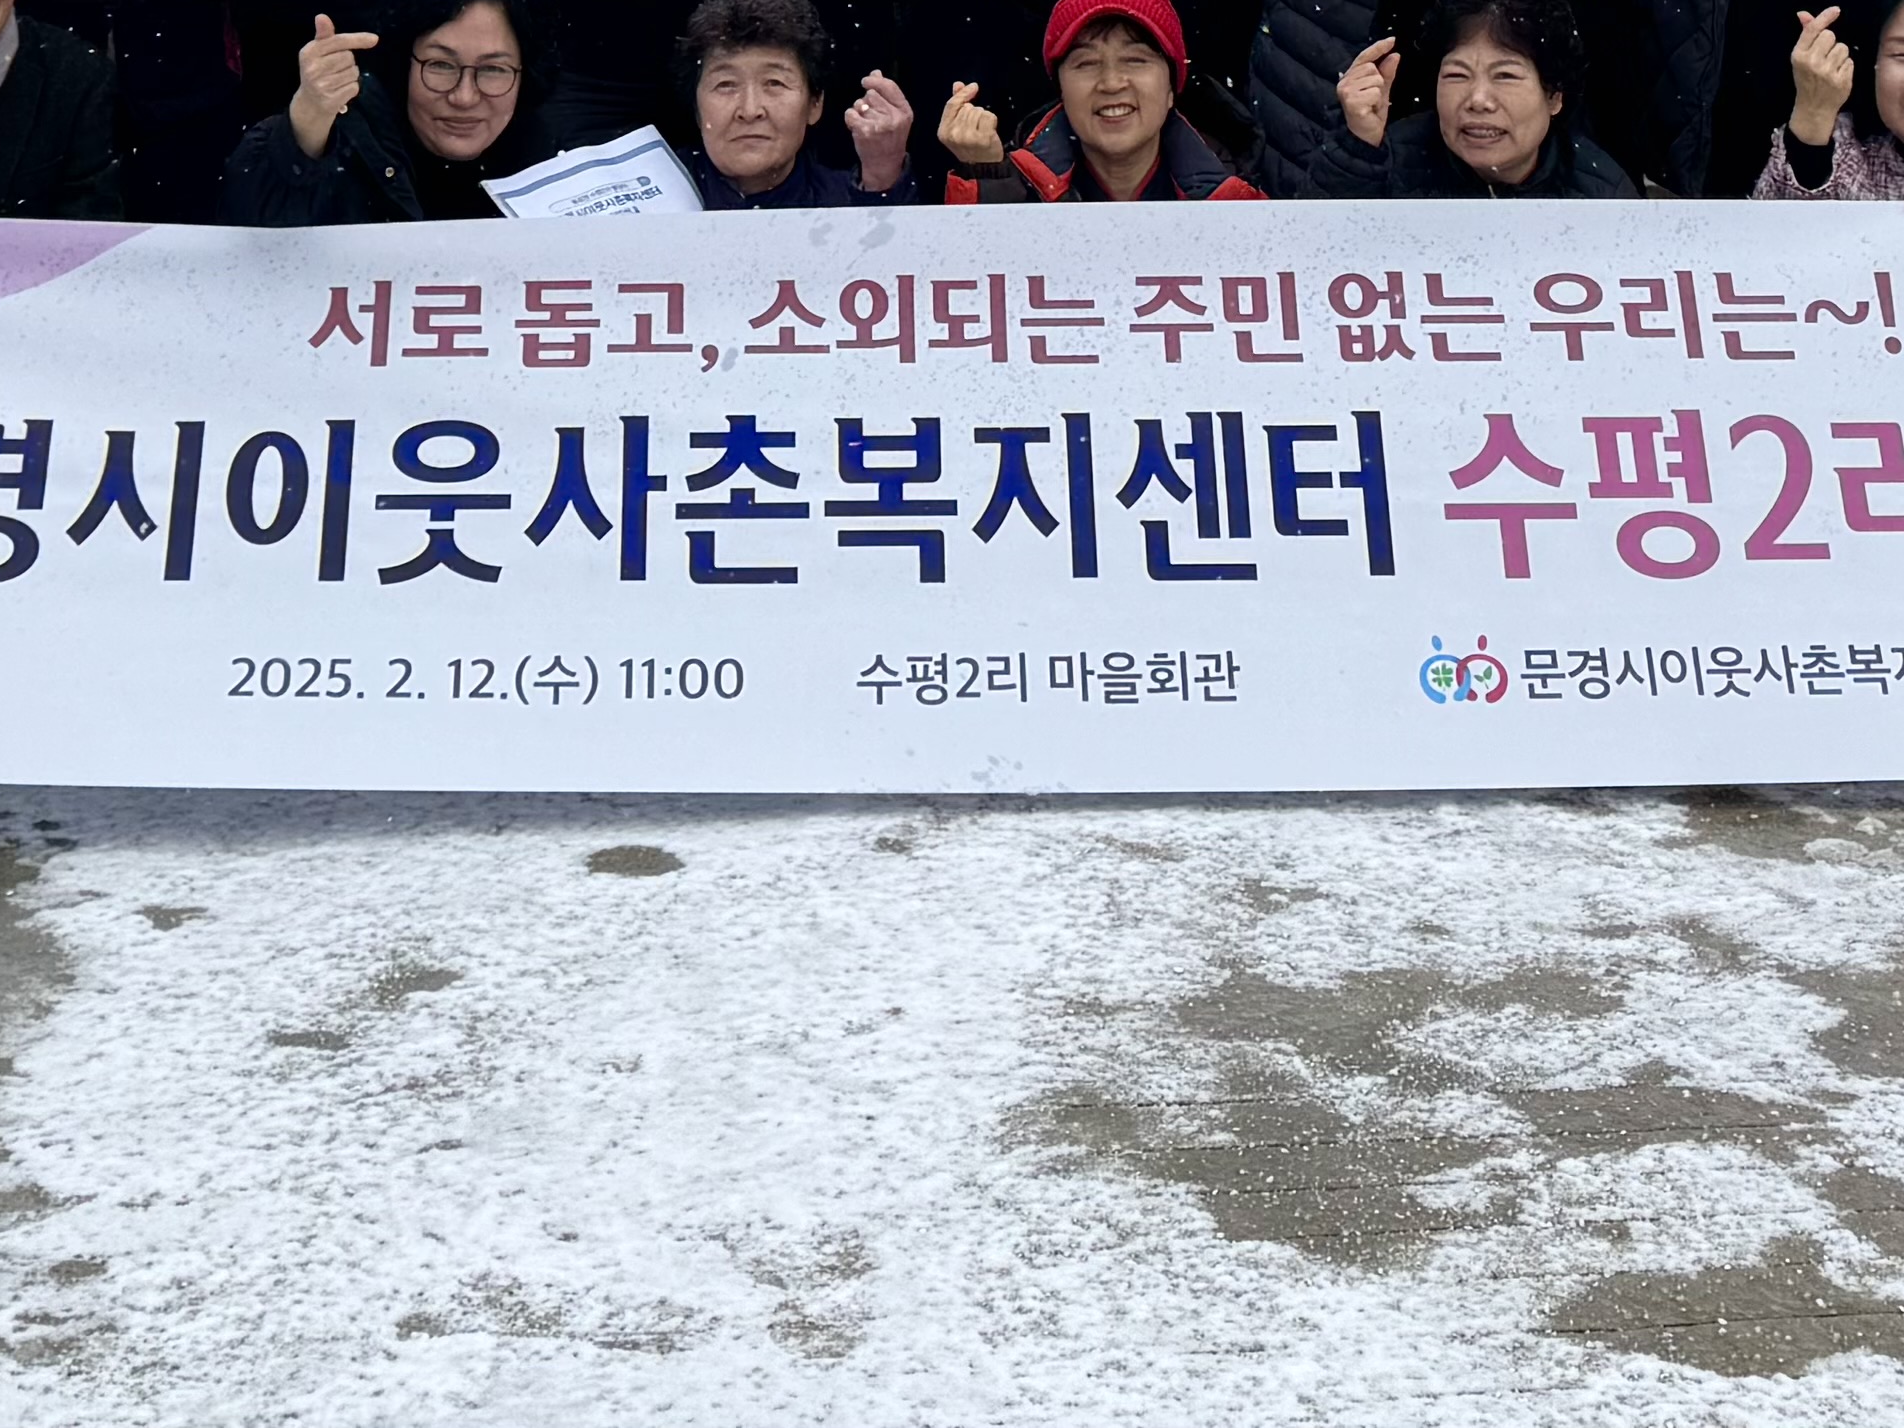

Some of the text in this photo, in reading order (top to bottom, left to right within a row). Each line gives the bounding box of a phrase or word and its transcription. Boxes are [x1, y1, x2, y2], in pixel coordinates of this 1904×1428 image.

[309, 270, 1902, 373] 서로 돕고, 소외되는 주민 없는 우리는~!
[227, 657, 364, 699] 2025.
[385, 657, 426, 699] 2.
[447, 654, 599, 706] 12.(수)
[619, 657, 745, 700] 11:00
[856, 651, 1028, 706] 수평2리
[1048, 650, 1240, 704] 마을회관
